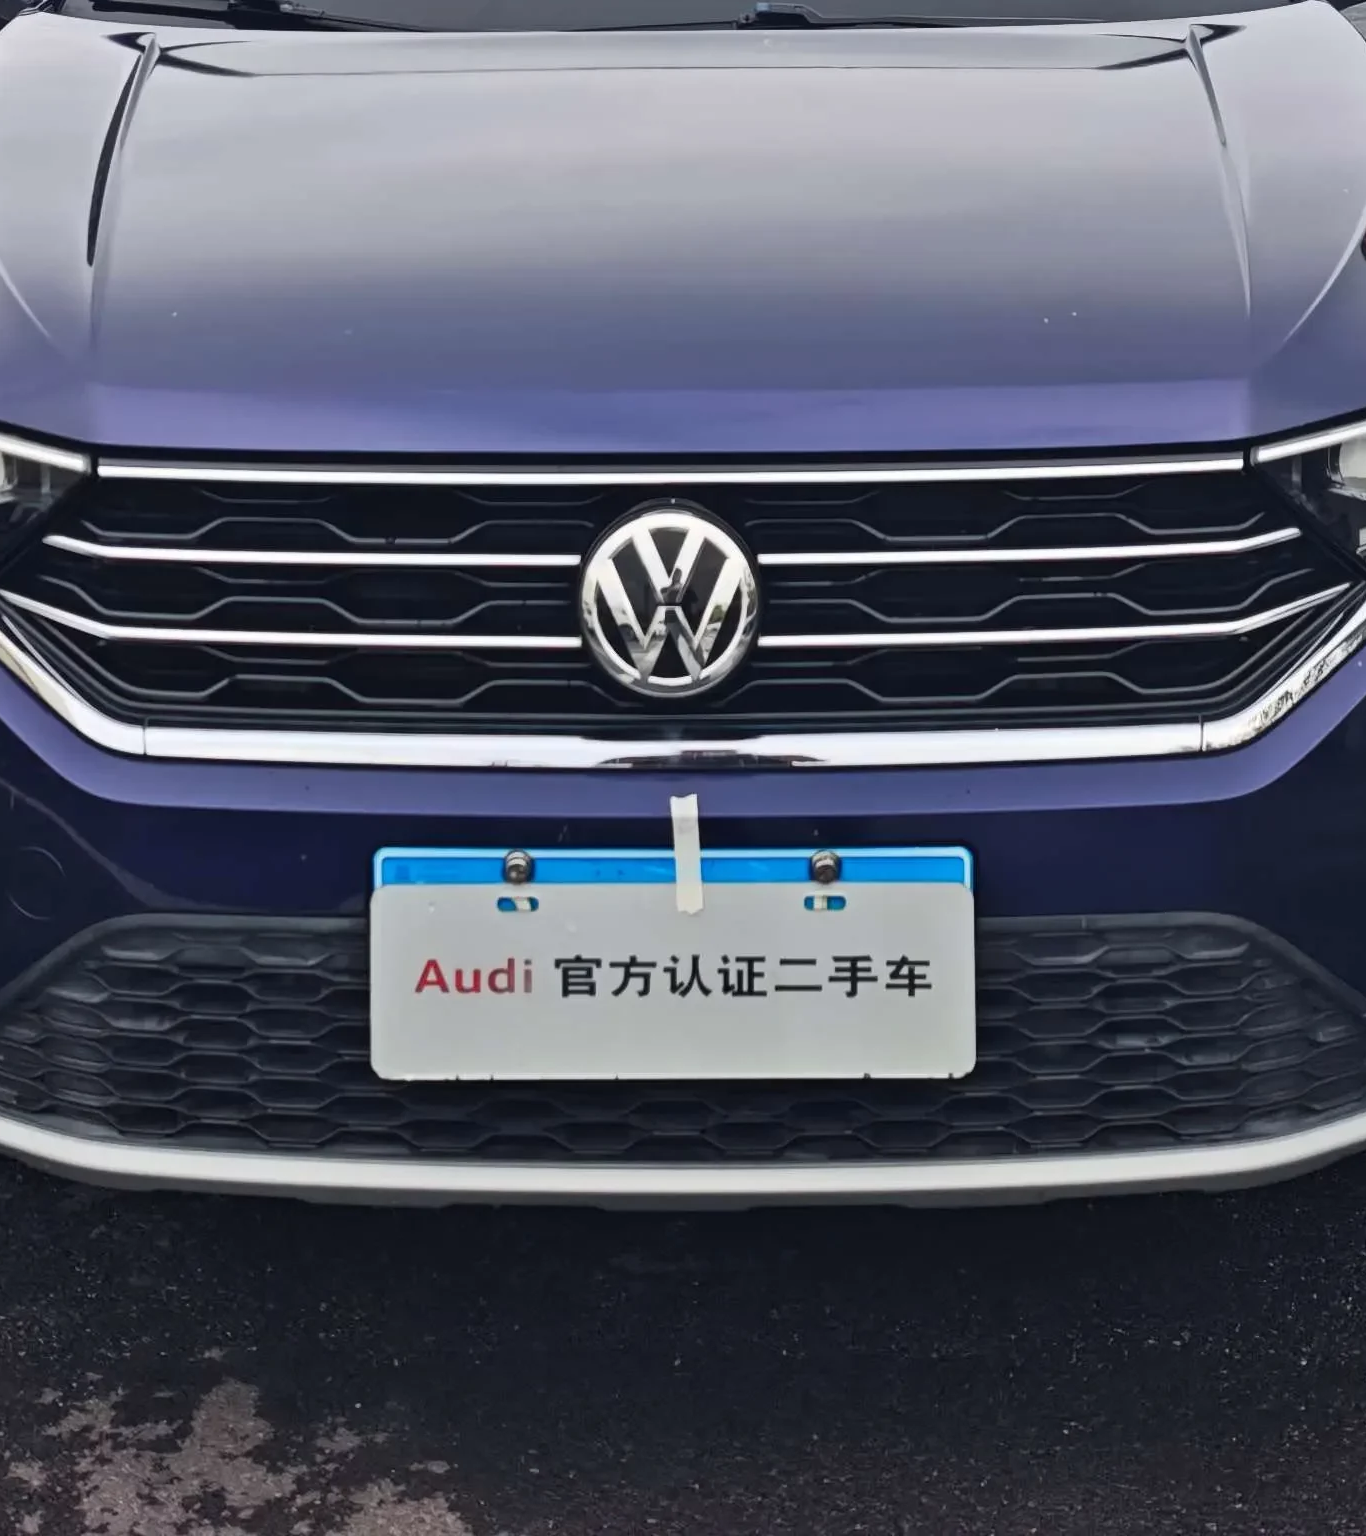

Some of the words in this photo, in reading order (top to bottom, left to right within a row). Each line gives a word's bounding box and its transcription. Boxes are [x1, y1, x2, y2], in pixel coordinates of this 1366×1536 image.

[414, 957, 534, 995] Audi
[553, 953, 934, 999] 官方认证二手车
